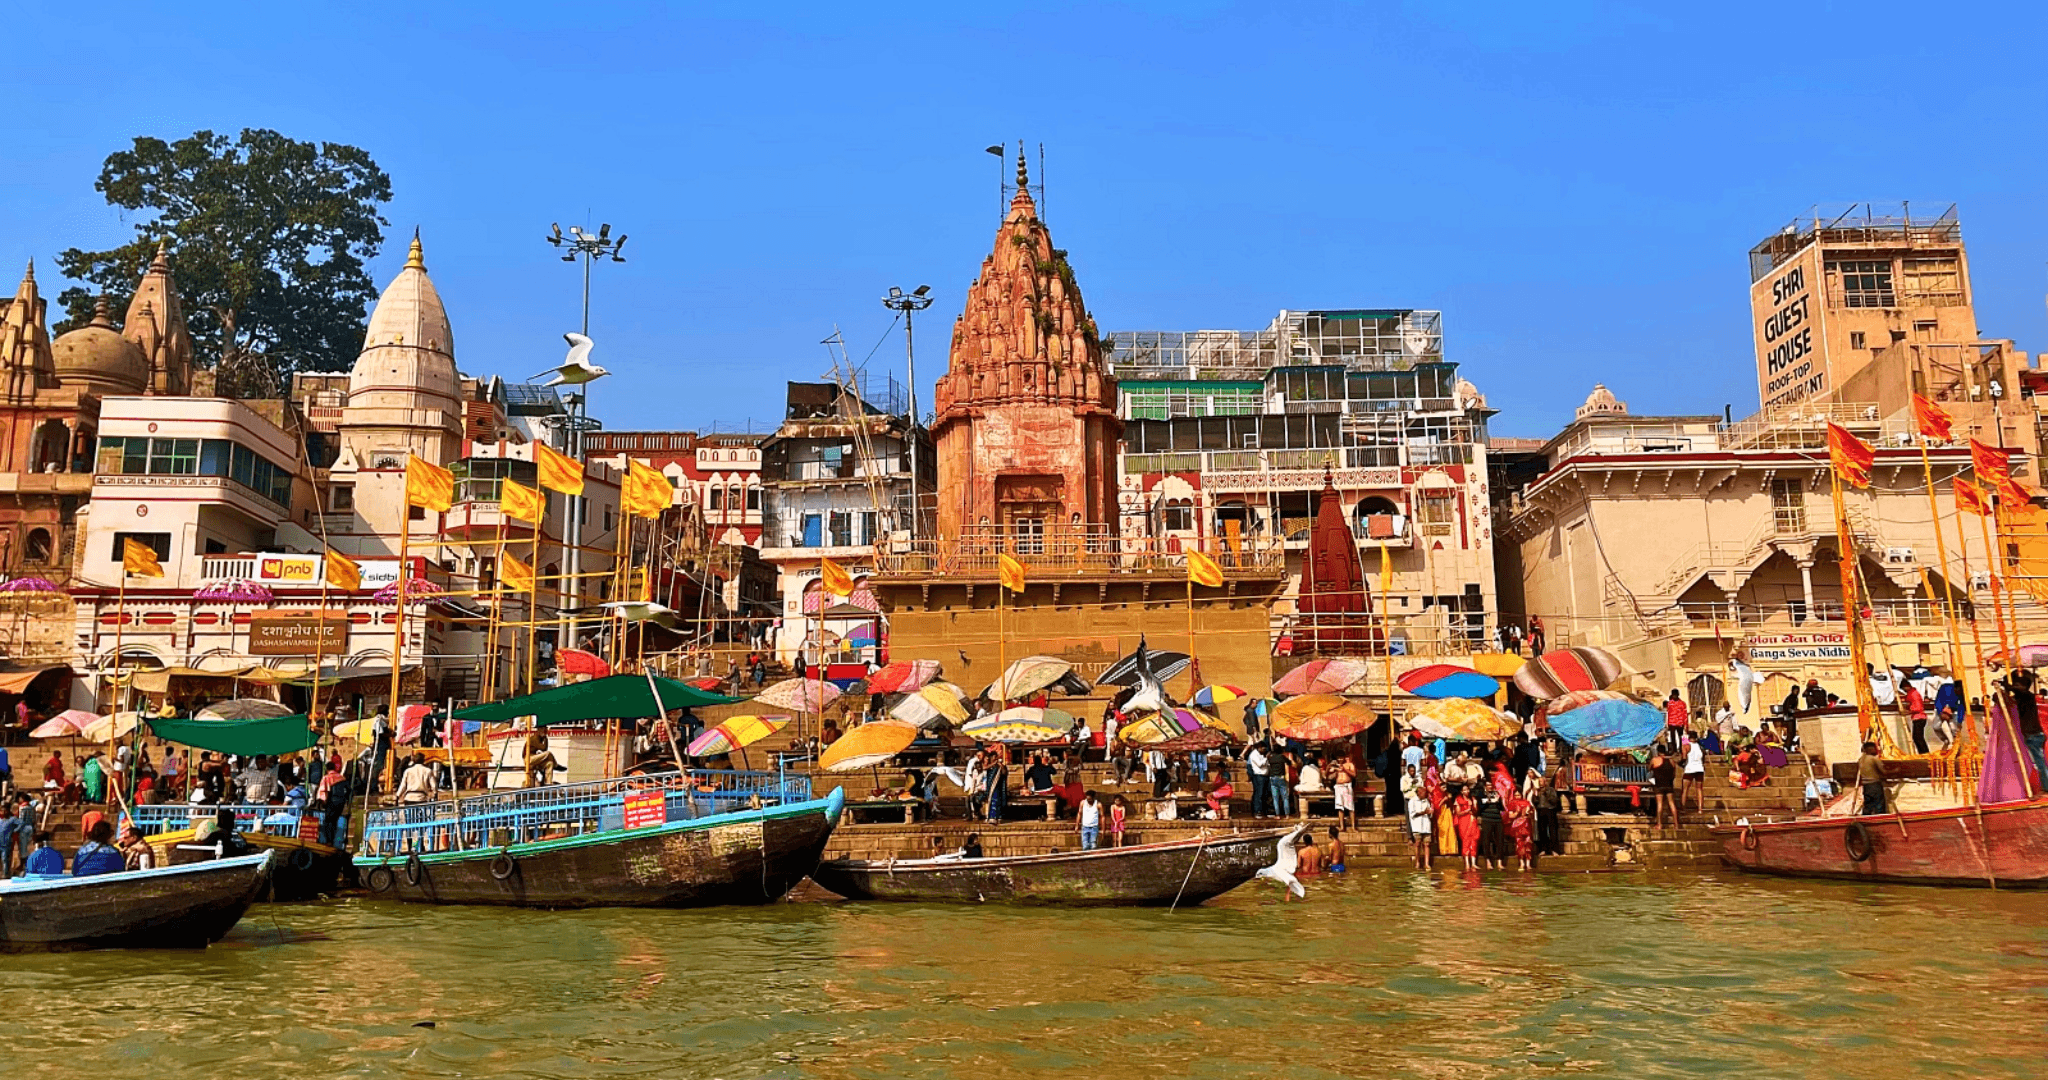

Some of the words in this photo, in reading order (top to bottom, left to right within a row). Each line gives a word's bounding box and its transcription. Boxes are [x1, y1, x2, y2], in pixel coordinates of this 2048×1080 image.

[1773, 265, 1804, 306] SHRI
[1765, 293, 1809, 343] GUEST
[1767, 326, 1812, 376] HOUSE
[1766, 358, 1813, 396] (ROOF-TOP)
[284, 562, 312, 578] pnb
[368, 570, 398, 581] sidbi
[1750, 648, 1786, 660] Ganga
[1787, 648, 1816, 658] Seva
[1818, 647, 1851, 657] Nidhi
